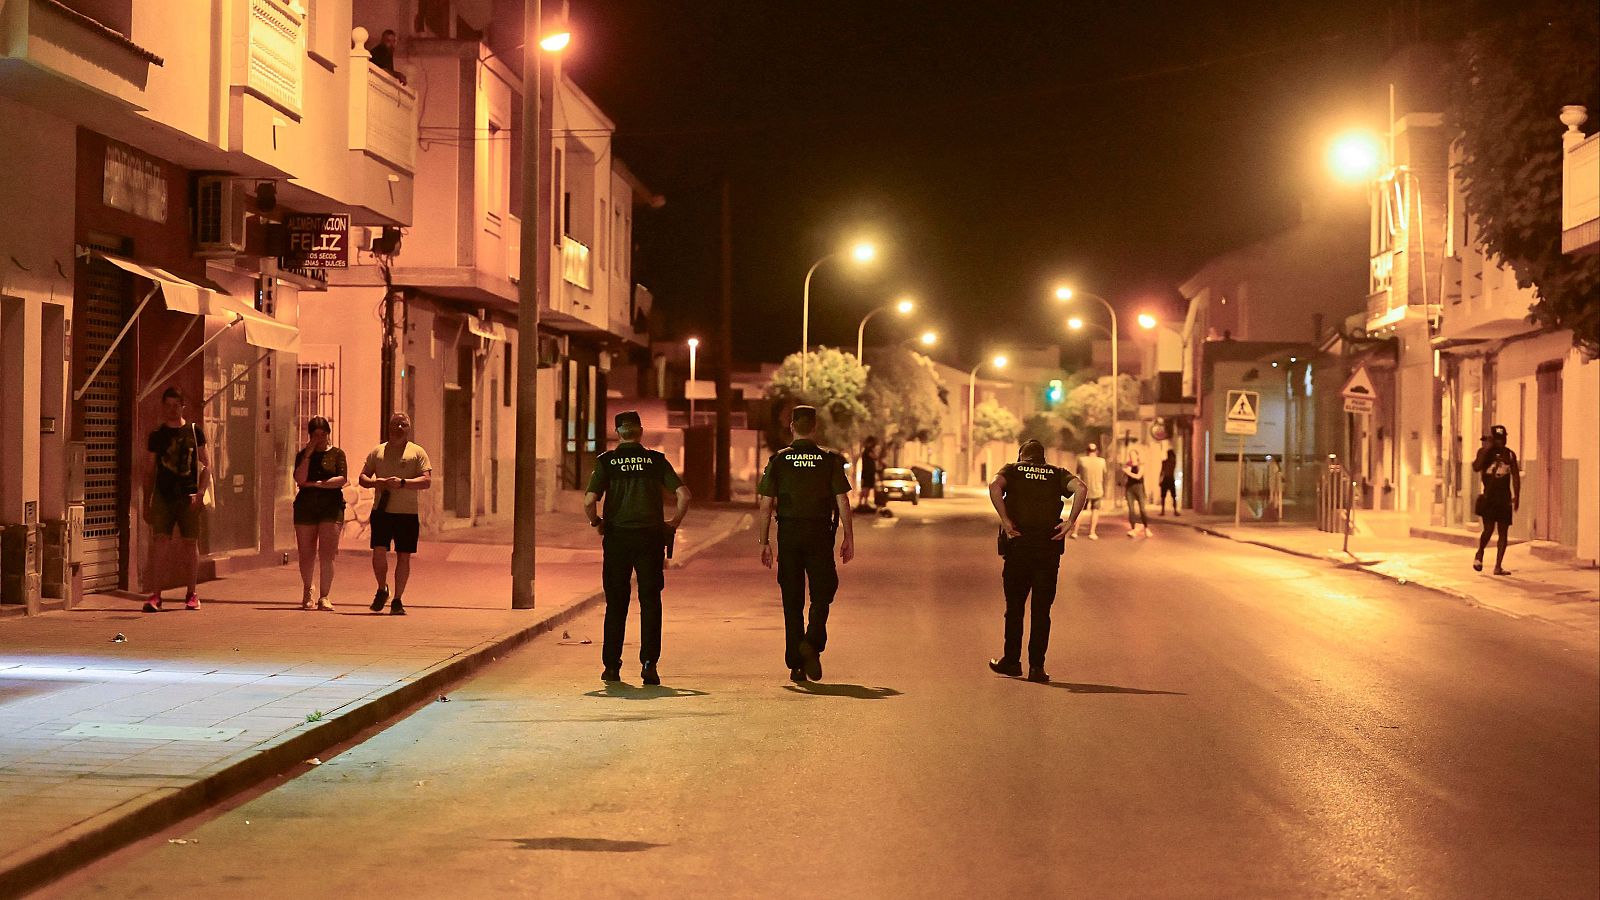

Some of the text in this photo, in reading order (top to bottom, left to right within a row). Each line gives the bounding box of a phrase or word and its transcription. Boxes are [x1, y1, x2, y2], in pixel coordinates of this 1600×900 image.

[289, 216, 347, 231] ALIMENTACION
[290, 233, 342, 251] FELIZ
[319, 252, 337, 260] SECOS
[610, 456, 653, 466] GUARDIA
[620, 463, 644, 472] CIVIL
[1017, 465, 1055, 475] GUARDIA
[1025, 472, 1048, 481] CIVIL
